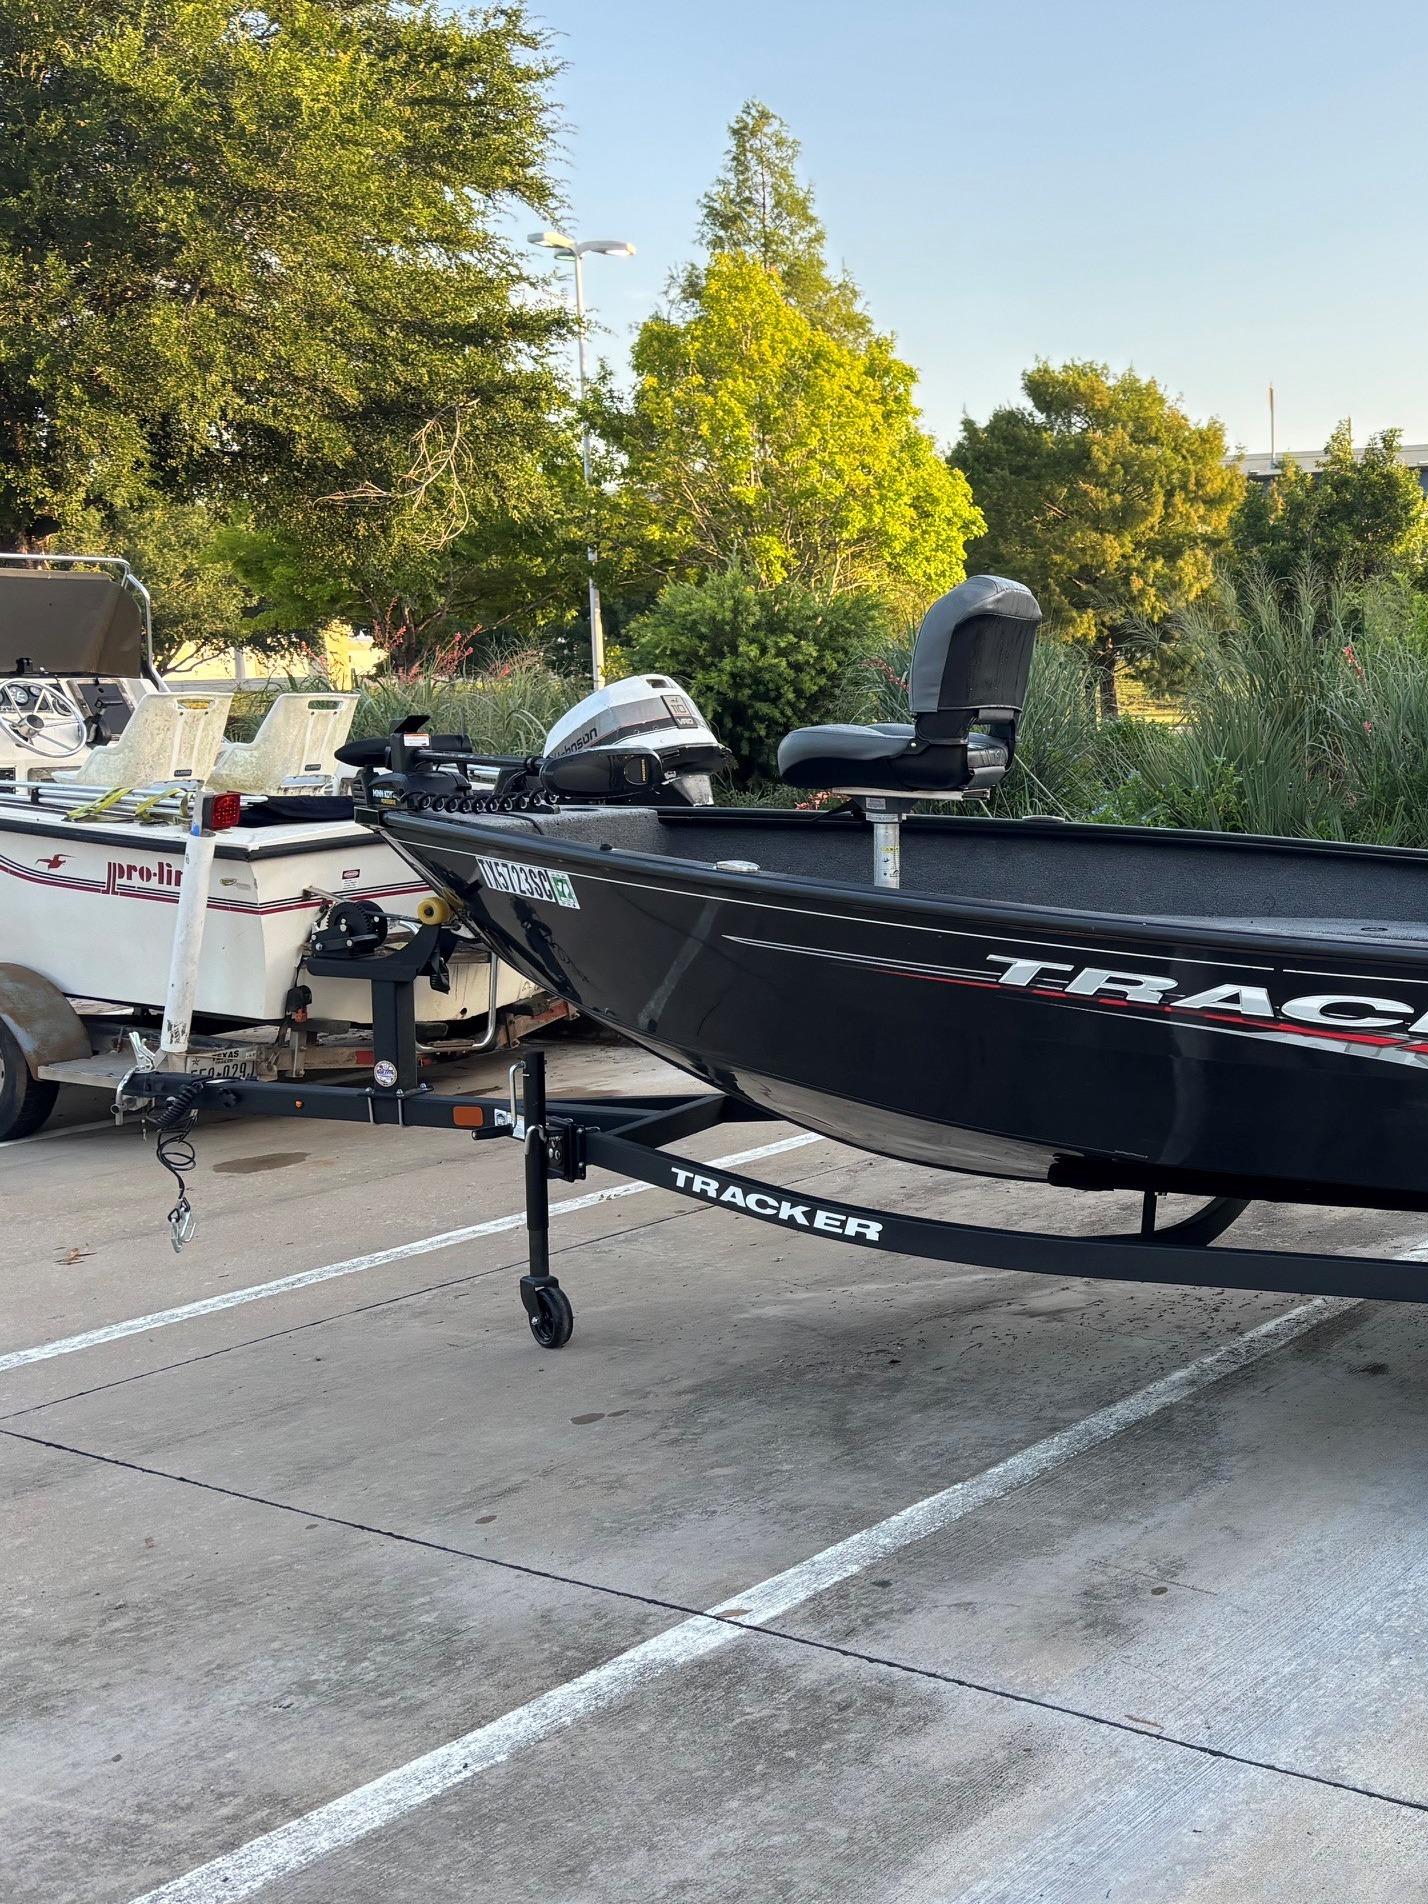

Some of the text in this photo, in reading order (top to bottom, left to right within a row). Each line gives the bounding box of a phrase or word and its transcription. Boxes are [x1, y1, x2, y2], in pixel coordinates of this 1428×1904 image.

[553, 727, 598, 759] hnson
[101, 861, 183, 895] pro-li
[477, 858, 554, 901] TX5723SC
[671, 1167, 884, 1242] TRACKER
